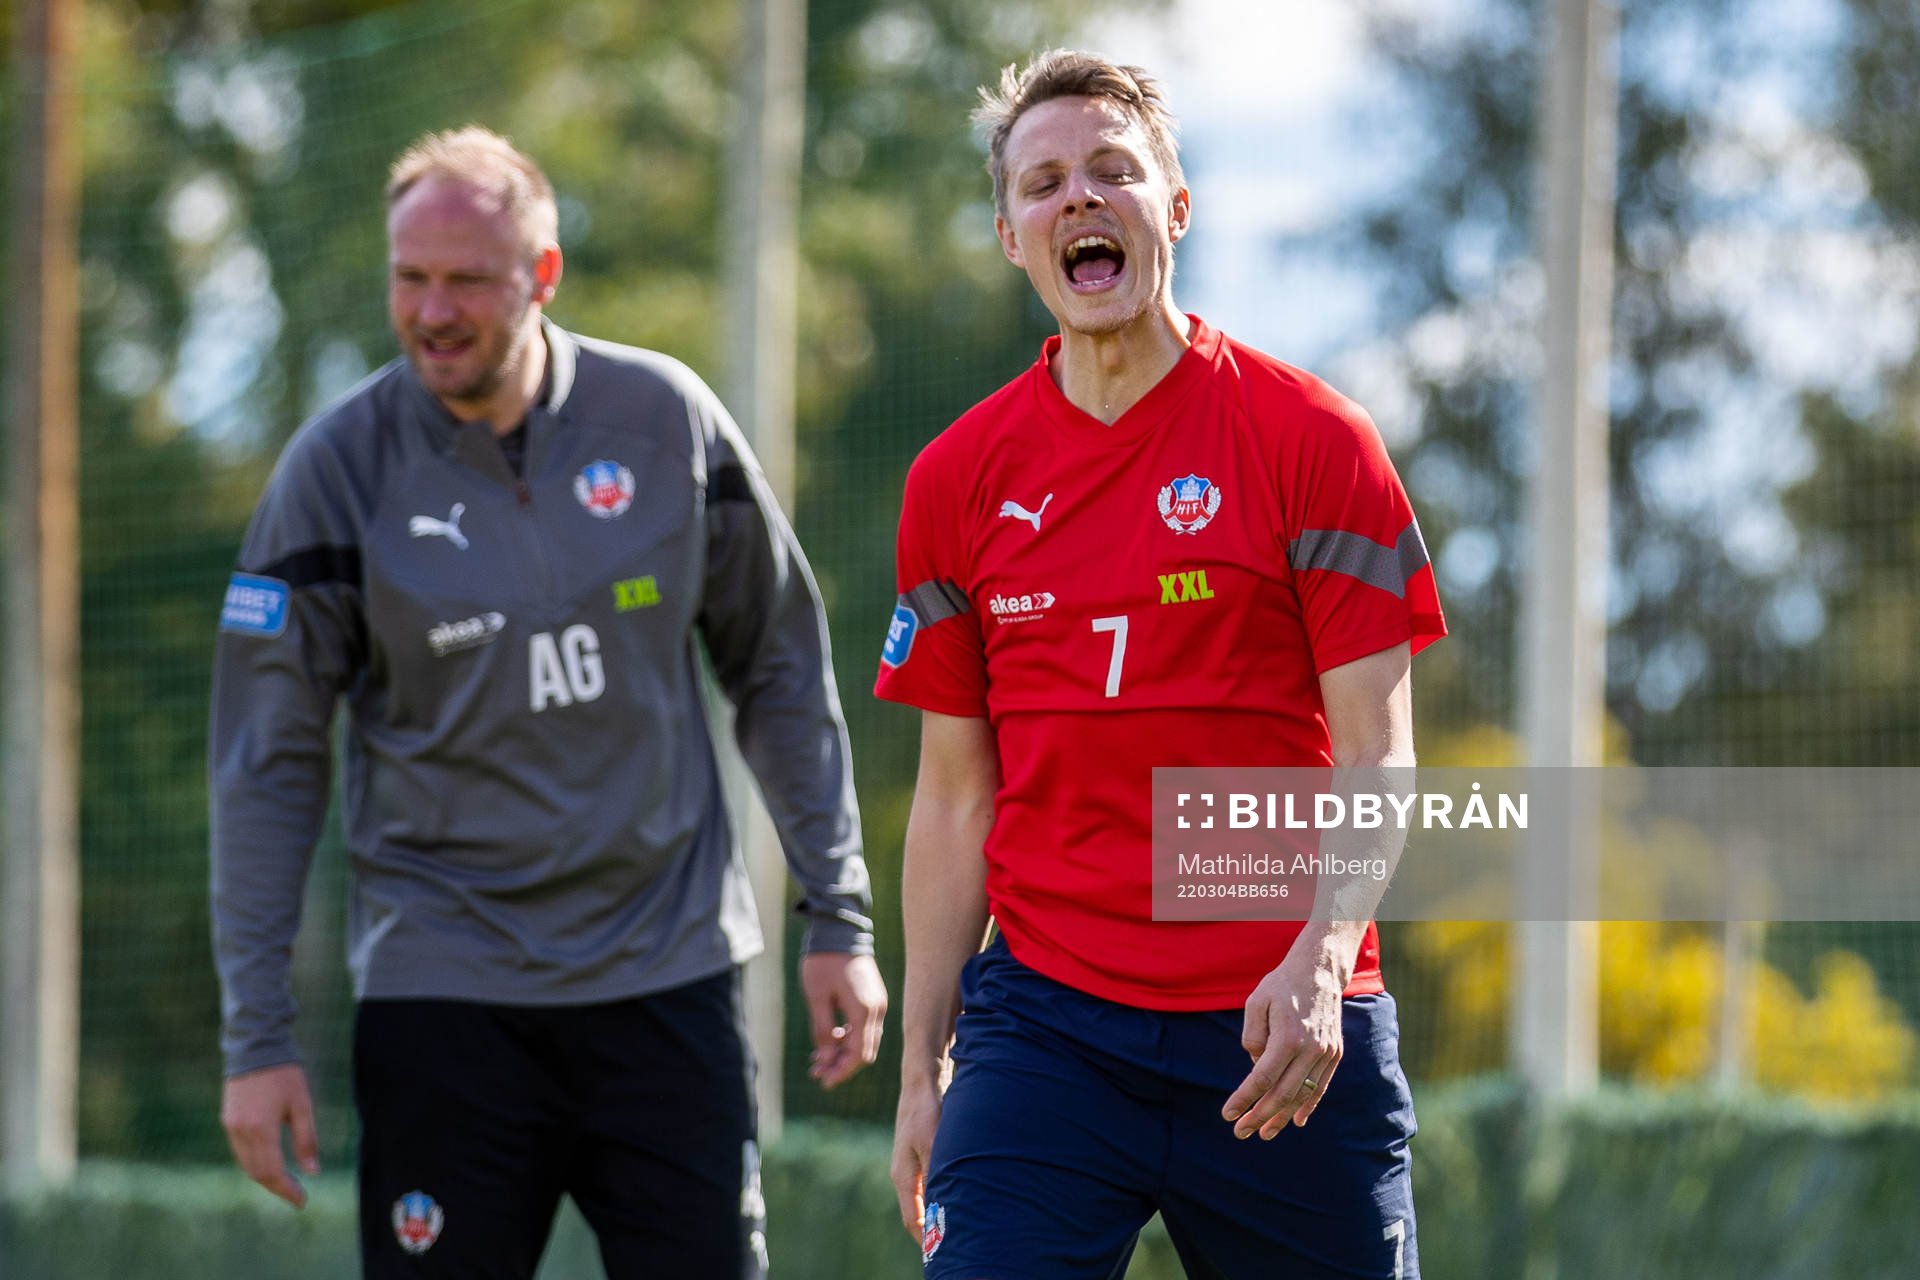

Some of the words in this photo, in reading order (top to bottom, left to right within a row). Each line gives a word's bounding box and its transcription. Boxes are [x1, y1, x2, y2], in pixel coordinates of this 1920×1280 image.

[1176, 502, 1199, 515] HIF
[990, 593, 1033, 615] akea
[1157, 569, 1215, 605] XXL
[529, 624, 606, 712] AG
[1091, 615, 1128, 698] 7
[1383, 1219, 1405, 1280] 7
